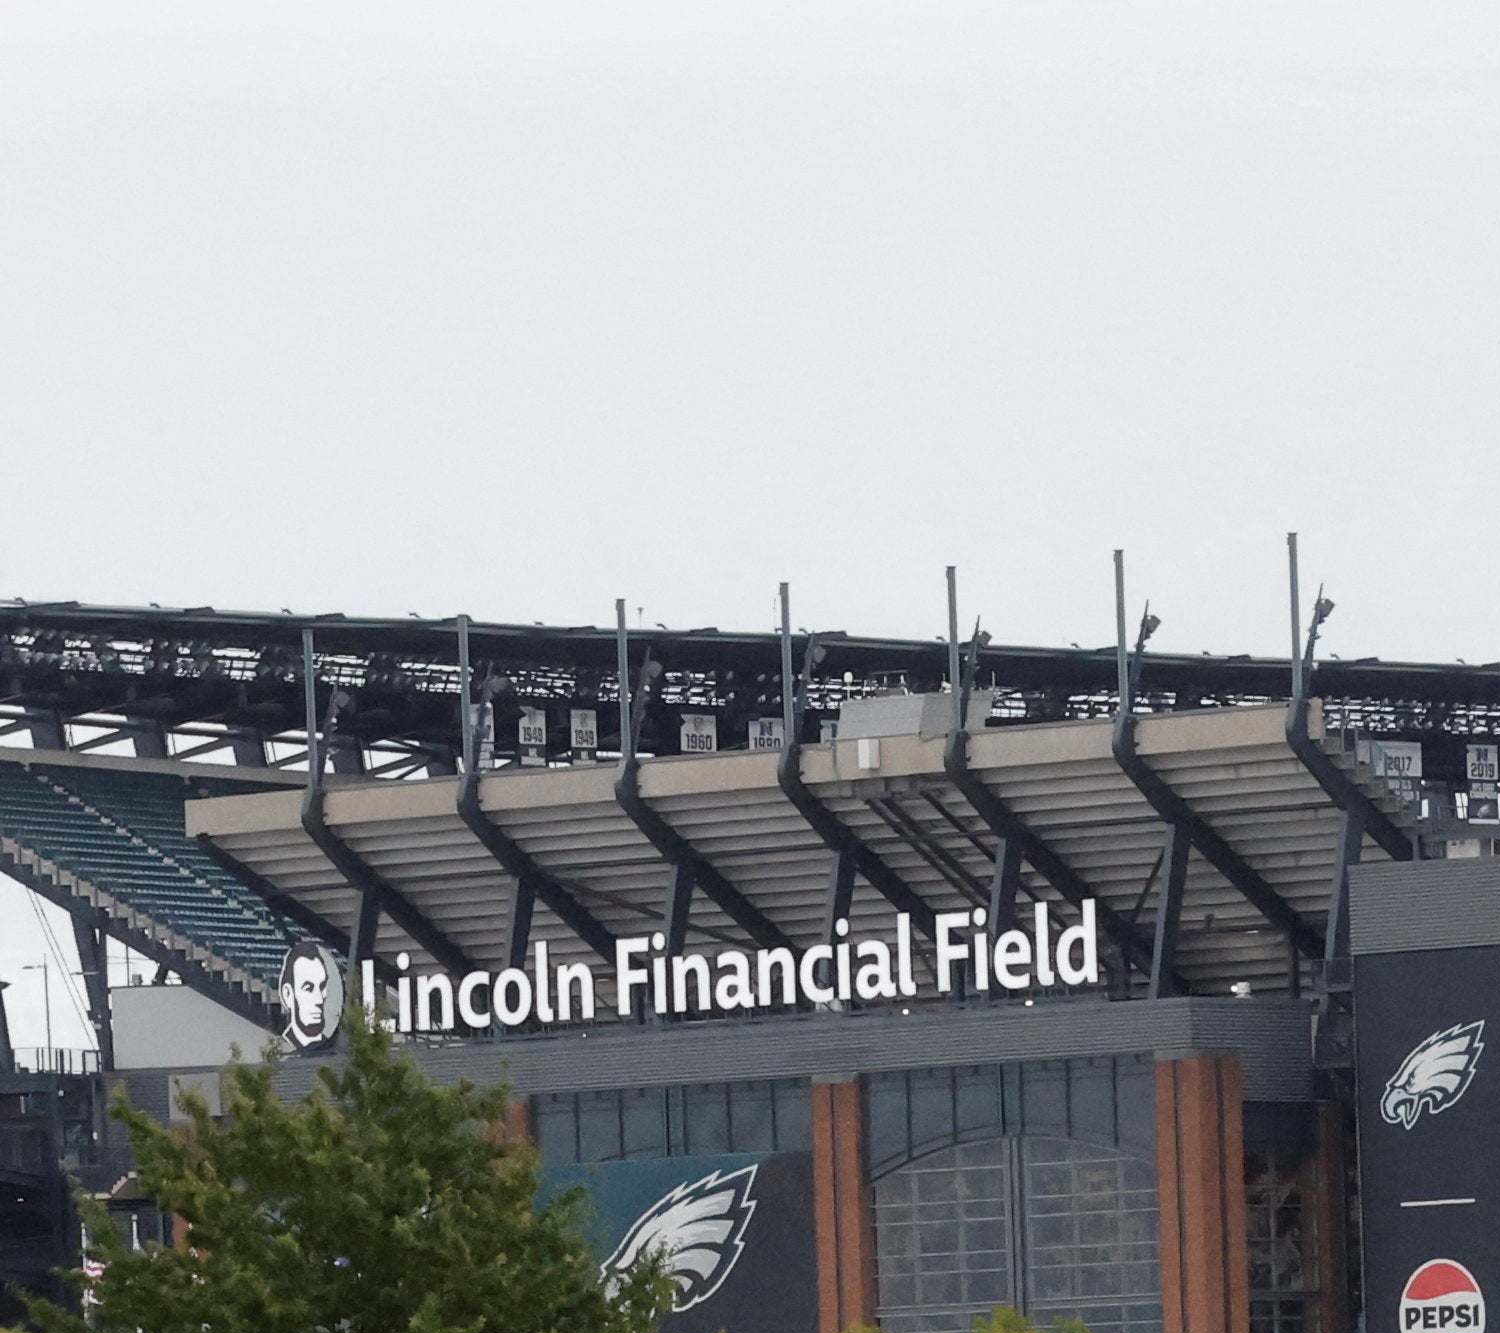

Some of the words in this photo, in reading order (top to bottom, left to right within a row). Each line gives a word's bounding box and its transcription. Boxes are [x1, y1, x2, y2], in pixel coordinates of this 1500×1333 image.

[362, 939, 596, 1033] Lincoln
[615, 911, 917, 1016] Financial
[934, 898, 1100, 992] Field
[1405, 1304, 1480, 1330] PEPSI
